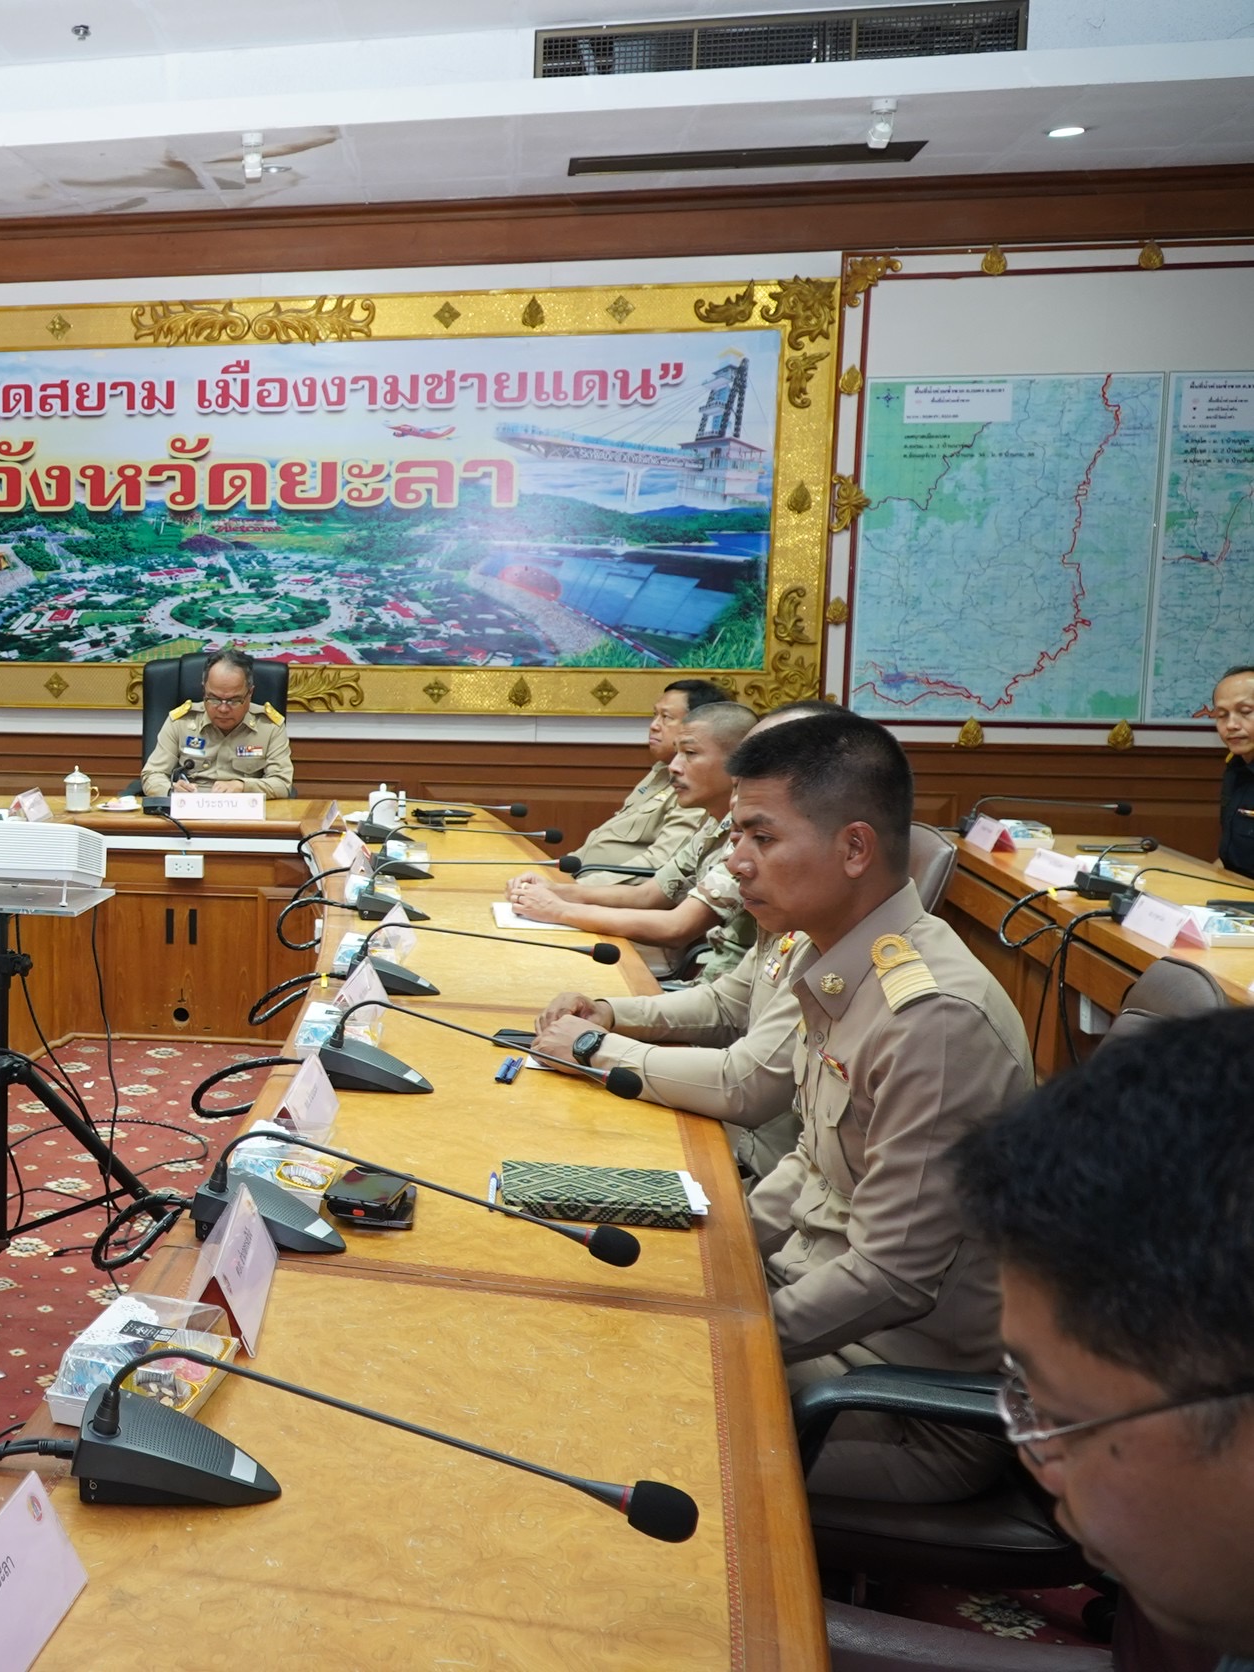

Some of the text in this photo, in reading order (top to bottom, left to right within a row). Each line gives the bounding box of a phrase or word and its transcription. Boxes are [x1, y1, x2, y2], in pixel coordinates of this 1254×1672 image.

[197, 359, 685, 412] เมืองงามชายแดน”
[196, 798, 238, 809] ประธาน
